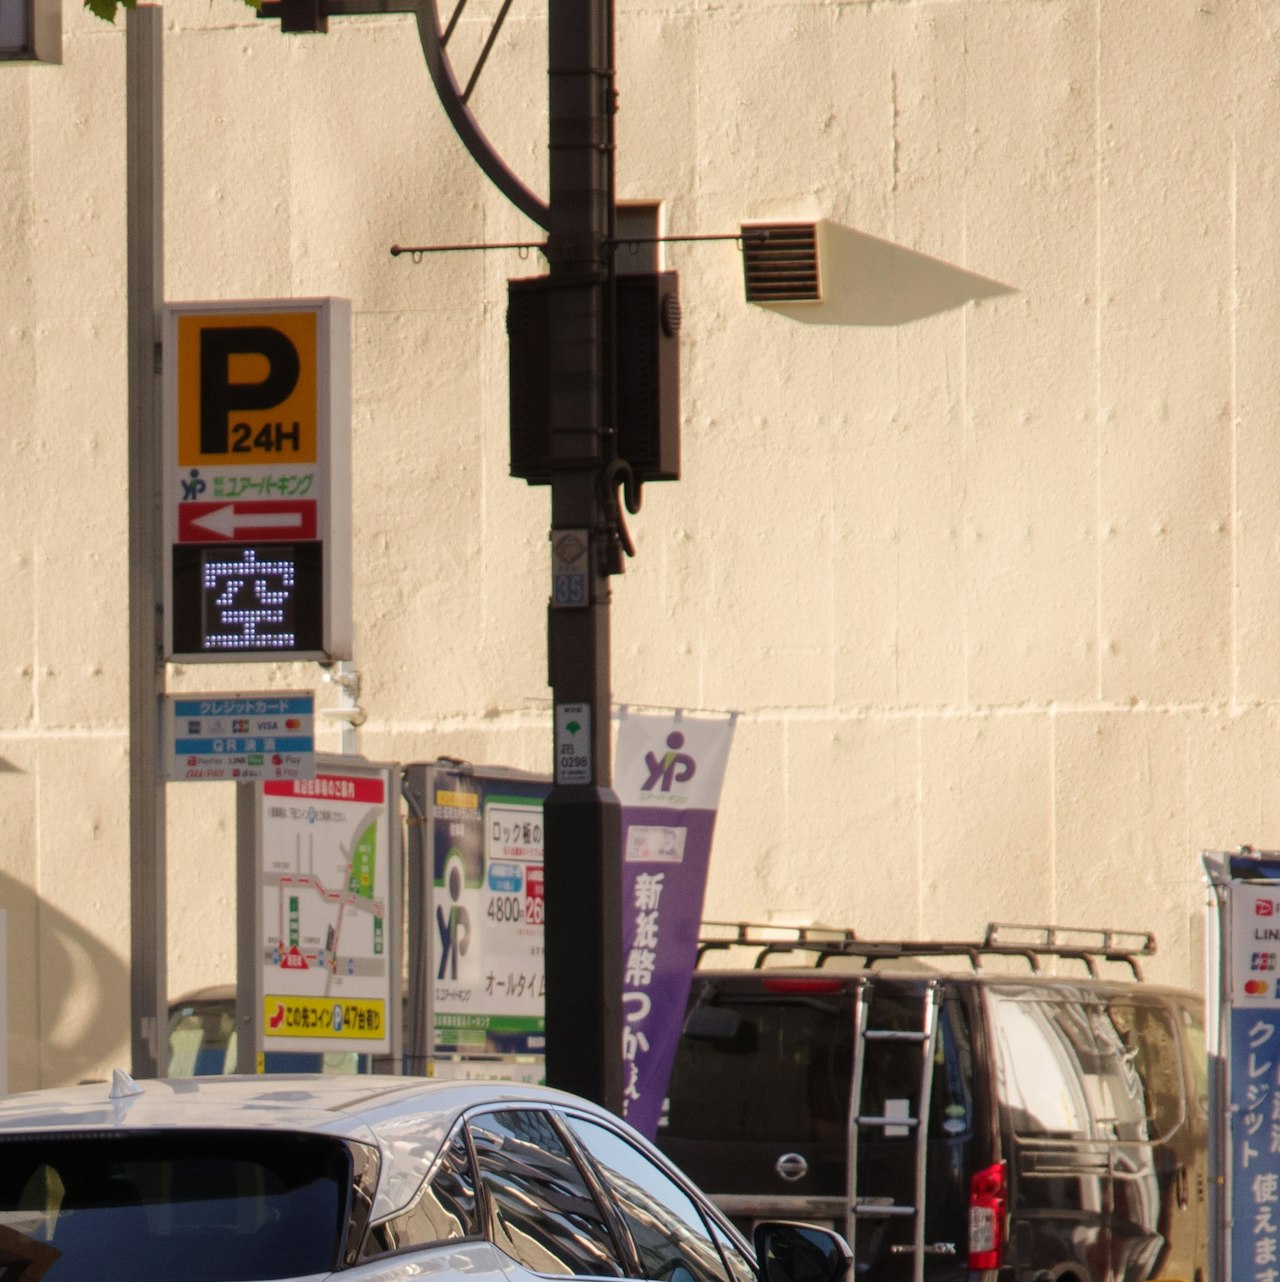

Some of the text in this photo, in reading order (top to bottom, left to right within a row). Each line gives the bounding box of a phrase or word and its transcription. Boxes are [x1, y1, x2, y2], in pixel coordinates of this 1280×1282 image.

[200, 326, 301, 454] P
[231, 421, 301, 453] 24H
[204, 550, 295, 647] 空
[200, 701, 289, 714] クレジットカード
[257, 721, 279, 730] VISA
[561, 756, 588, 768] 0298
[526, 896, 545, 924] 26
[622, 872, 665, 1117] 新紙幣つかえ
[1239, 1019, 1275, 1168] クレジット
